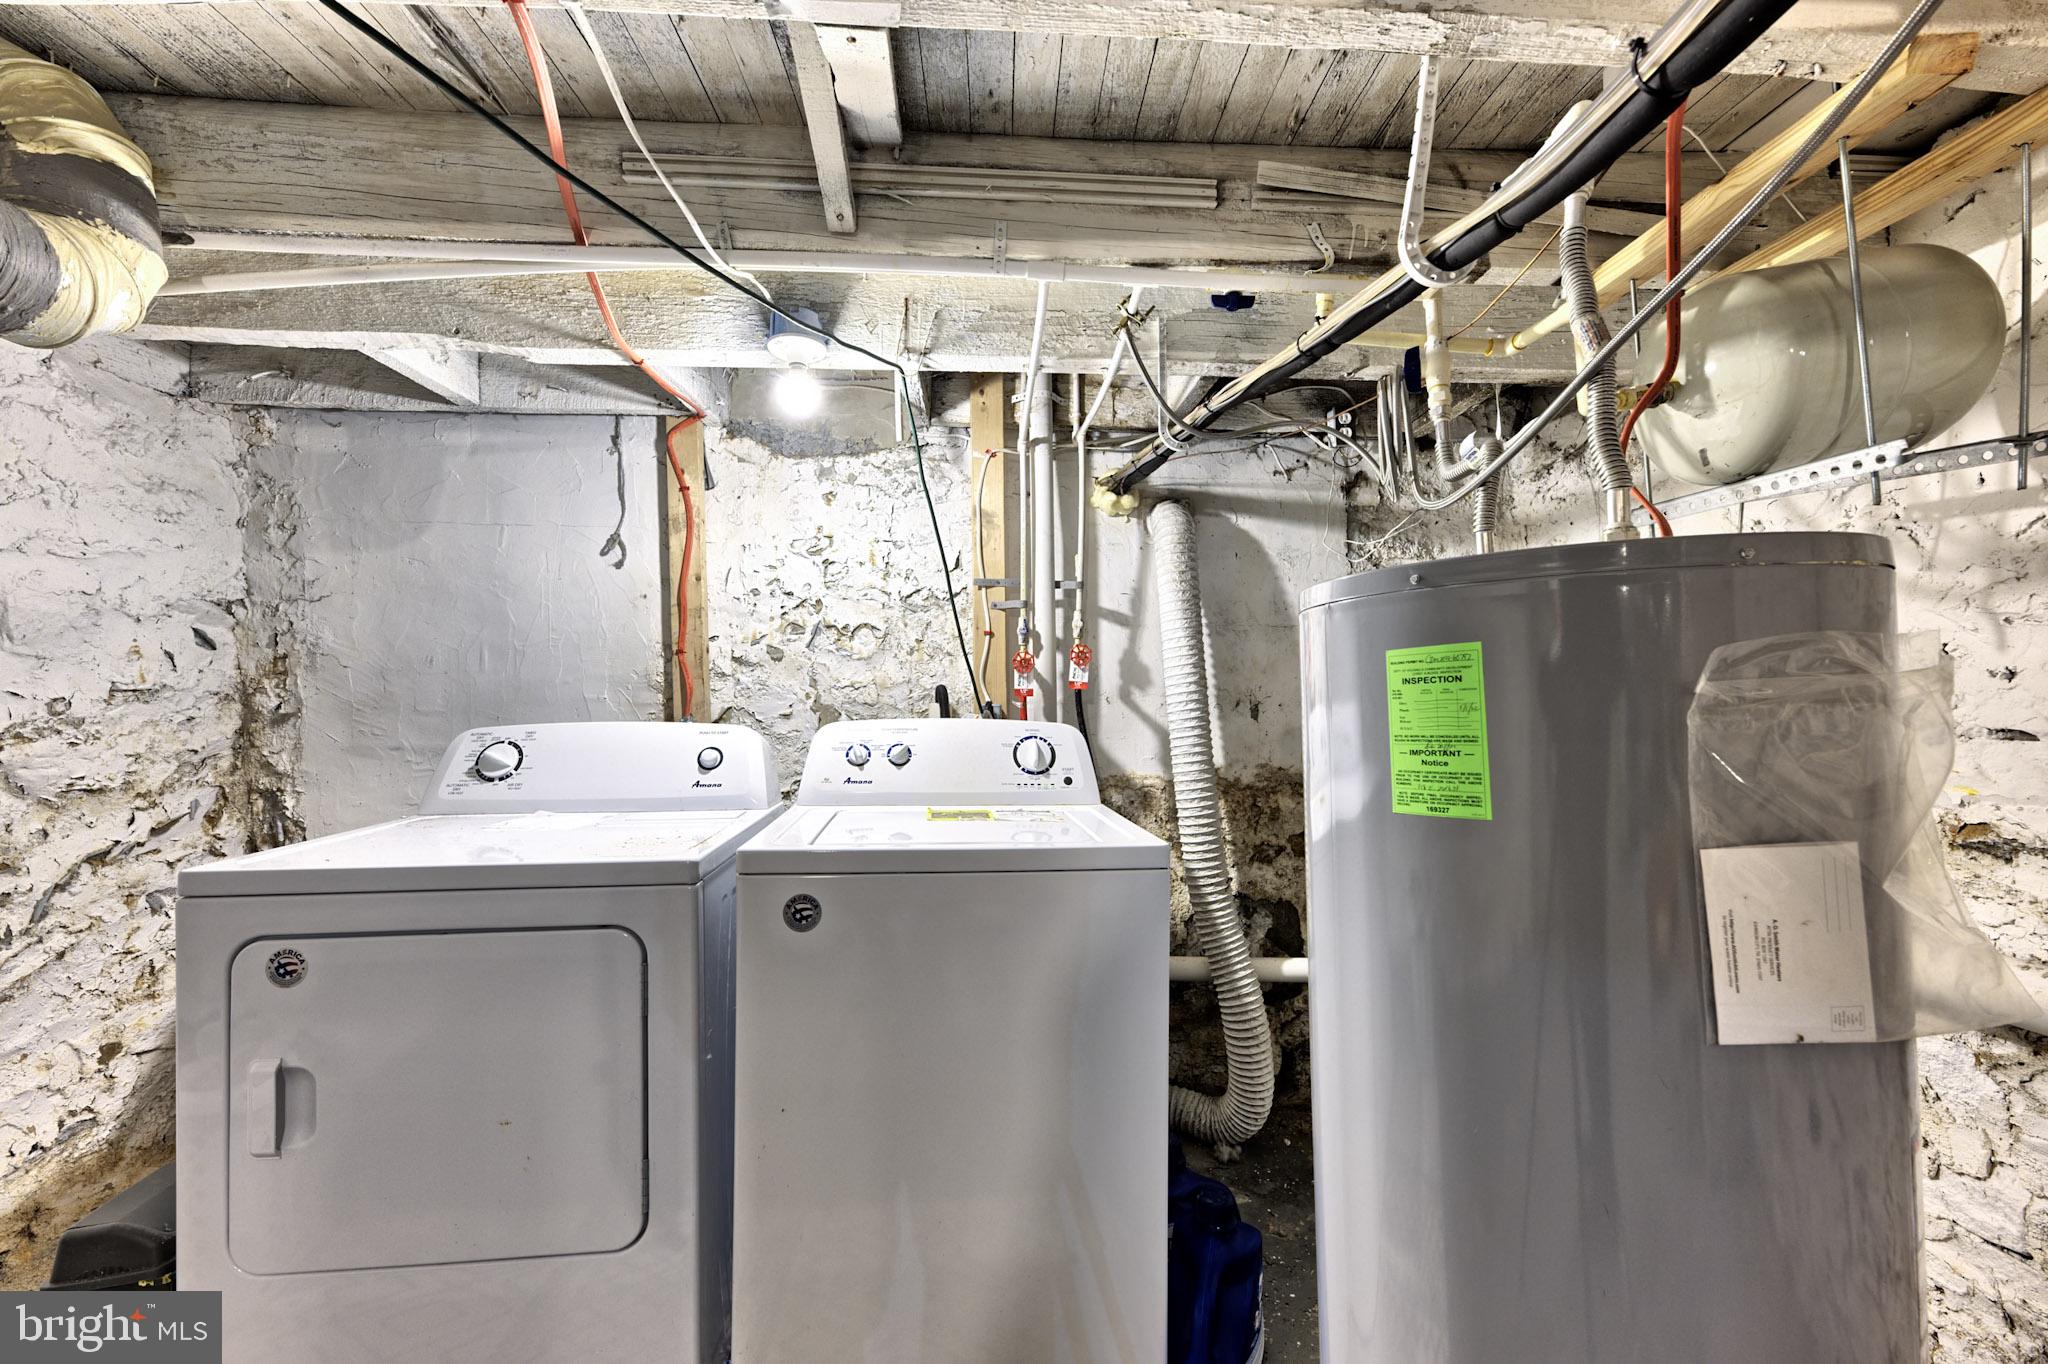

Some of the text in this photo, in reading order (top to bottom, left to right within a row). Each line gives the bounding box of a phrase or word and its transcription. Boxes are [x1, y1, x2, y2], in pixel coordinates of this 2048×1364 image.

[1402, 675, 1463, 685] INSPECTION
[1409, 749, 1462, 757] IMPORTANT
[1421, 759, 1449, 767] Notice
[692, 780, 722, 788] Amana
[269, 949, 306, 965] AMERICA
